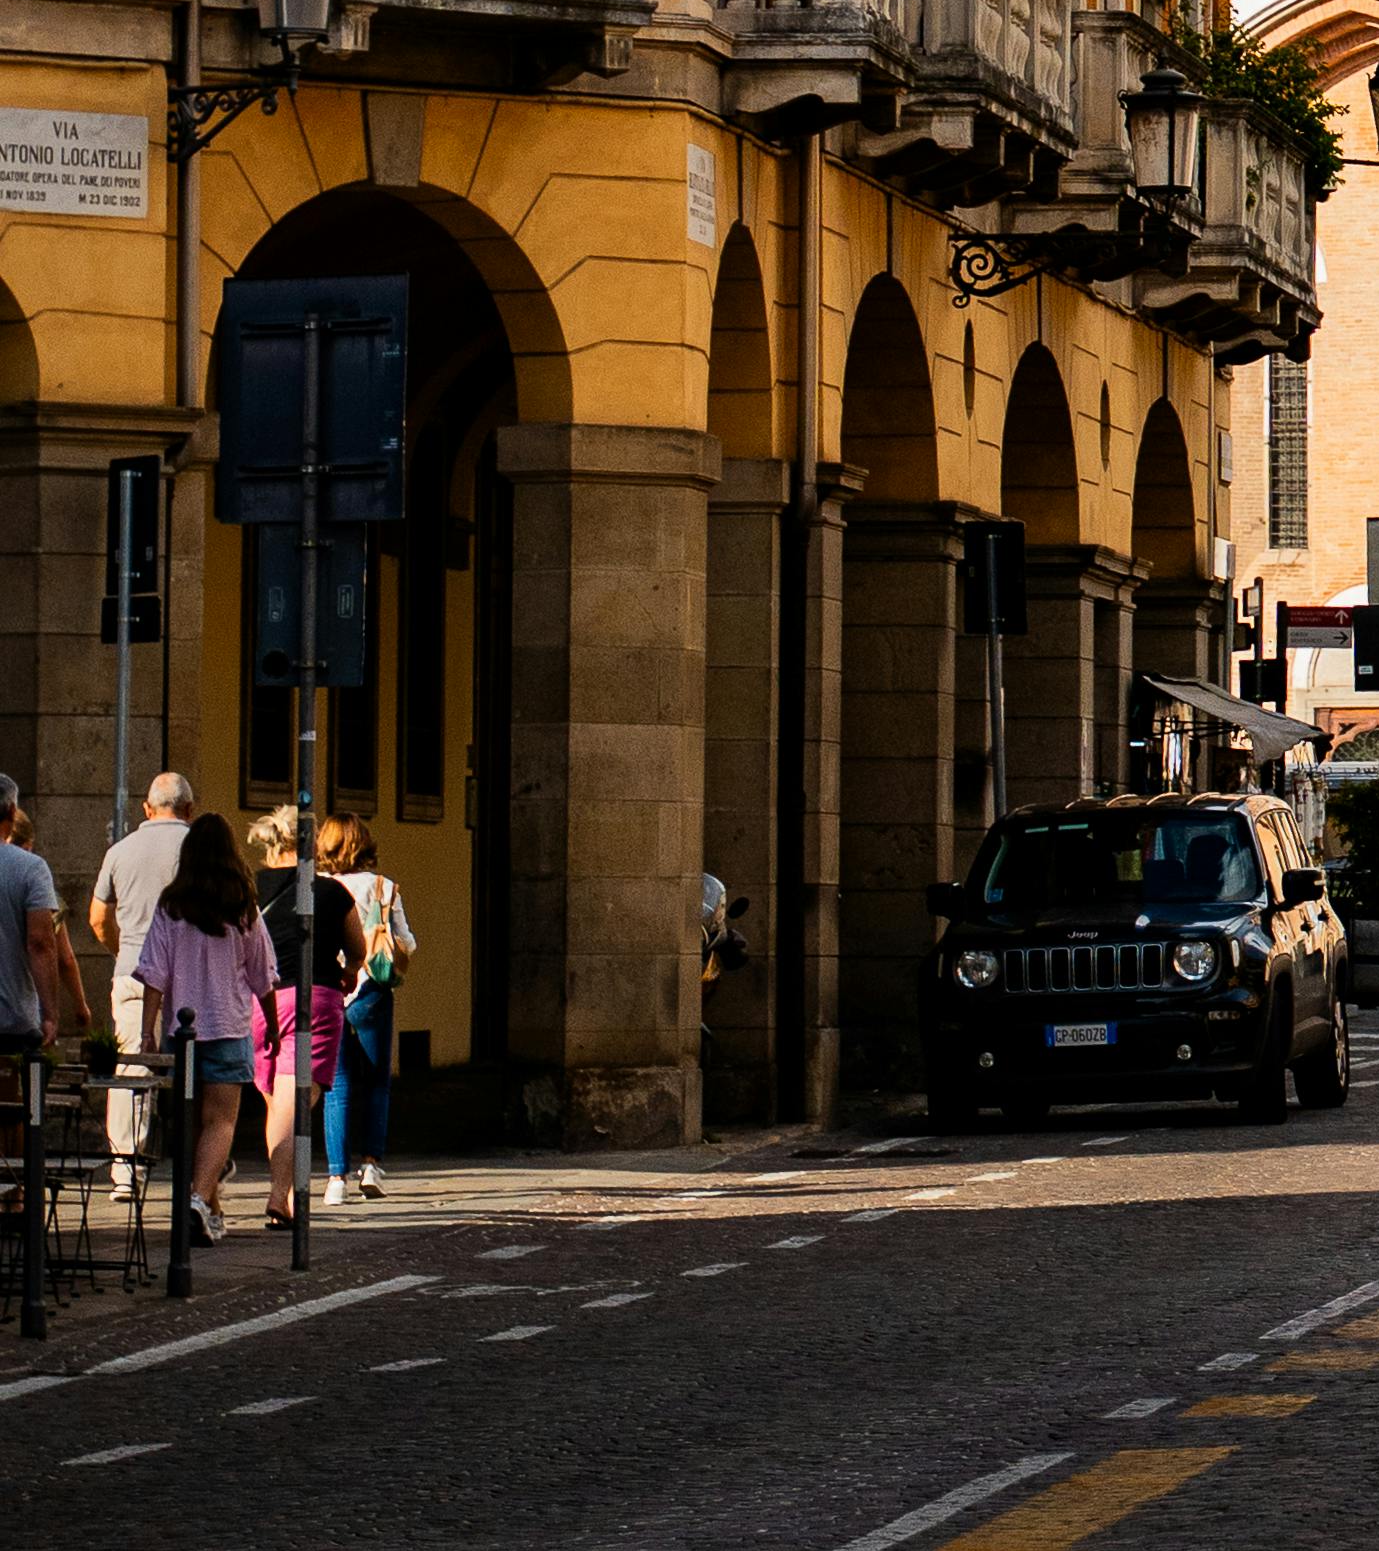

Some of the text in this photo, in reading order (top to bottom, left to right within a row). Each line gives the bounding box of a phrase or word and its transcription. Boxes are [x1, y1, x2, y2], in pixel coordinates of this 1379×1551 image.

[53, 121, 79, 140] VIA
[61, 147, 142, 170] LOCATELLI
[31, 172, 58, 184] OPERA
[61, 174, 76, 185] DEL
[79, 175, 99, 187] PANE
[1067, 931, 1099, 939] Jeep
